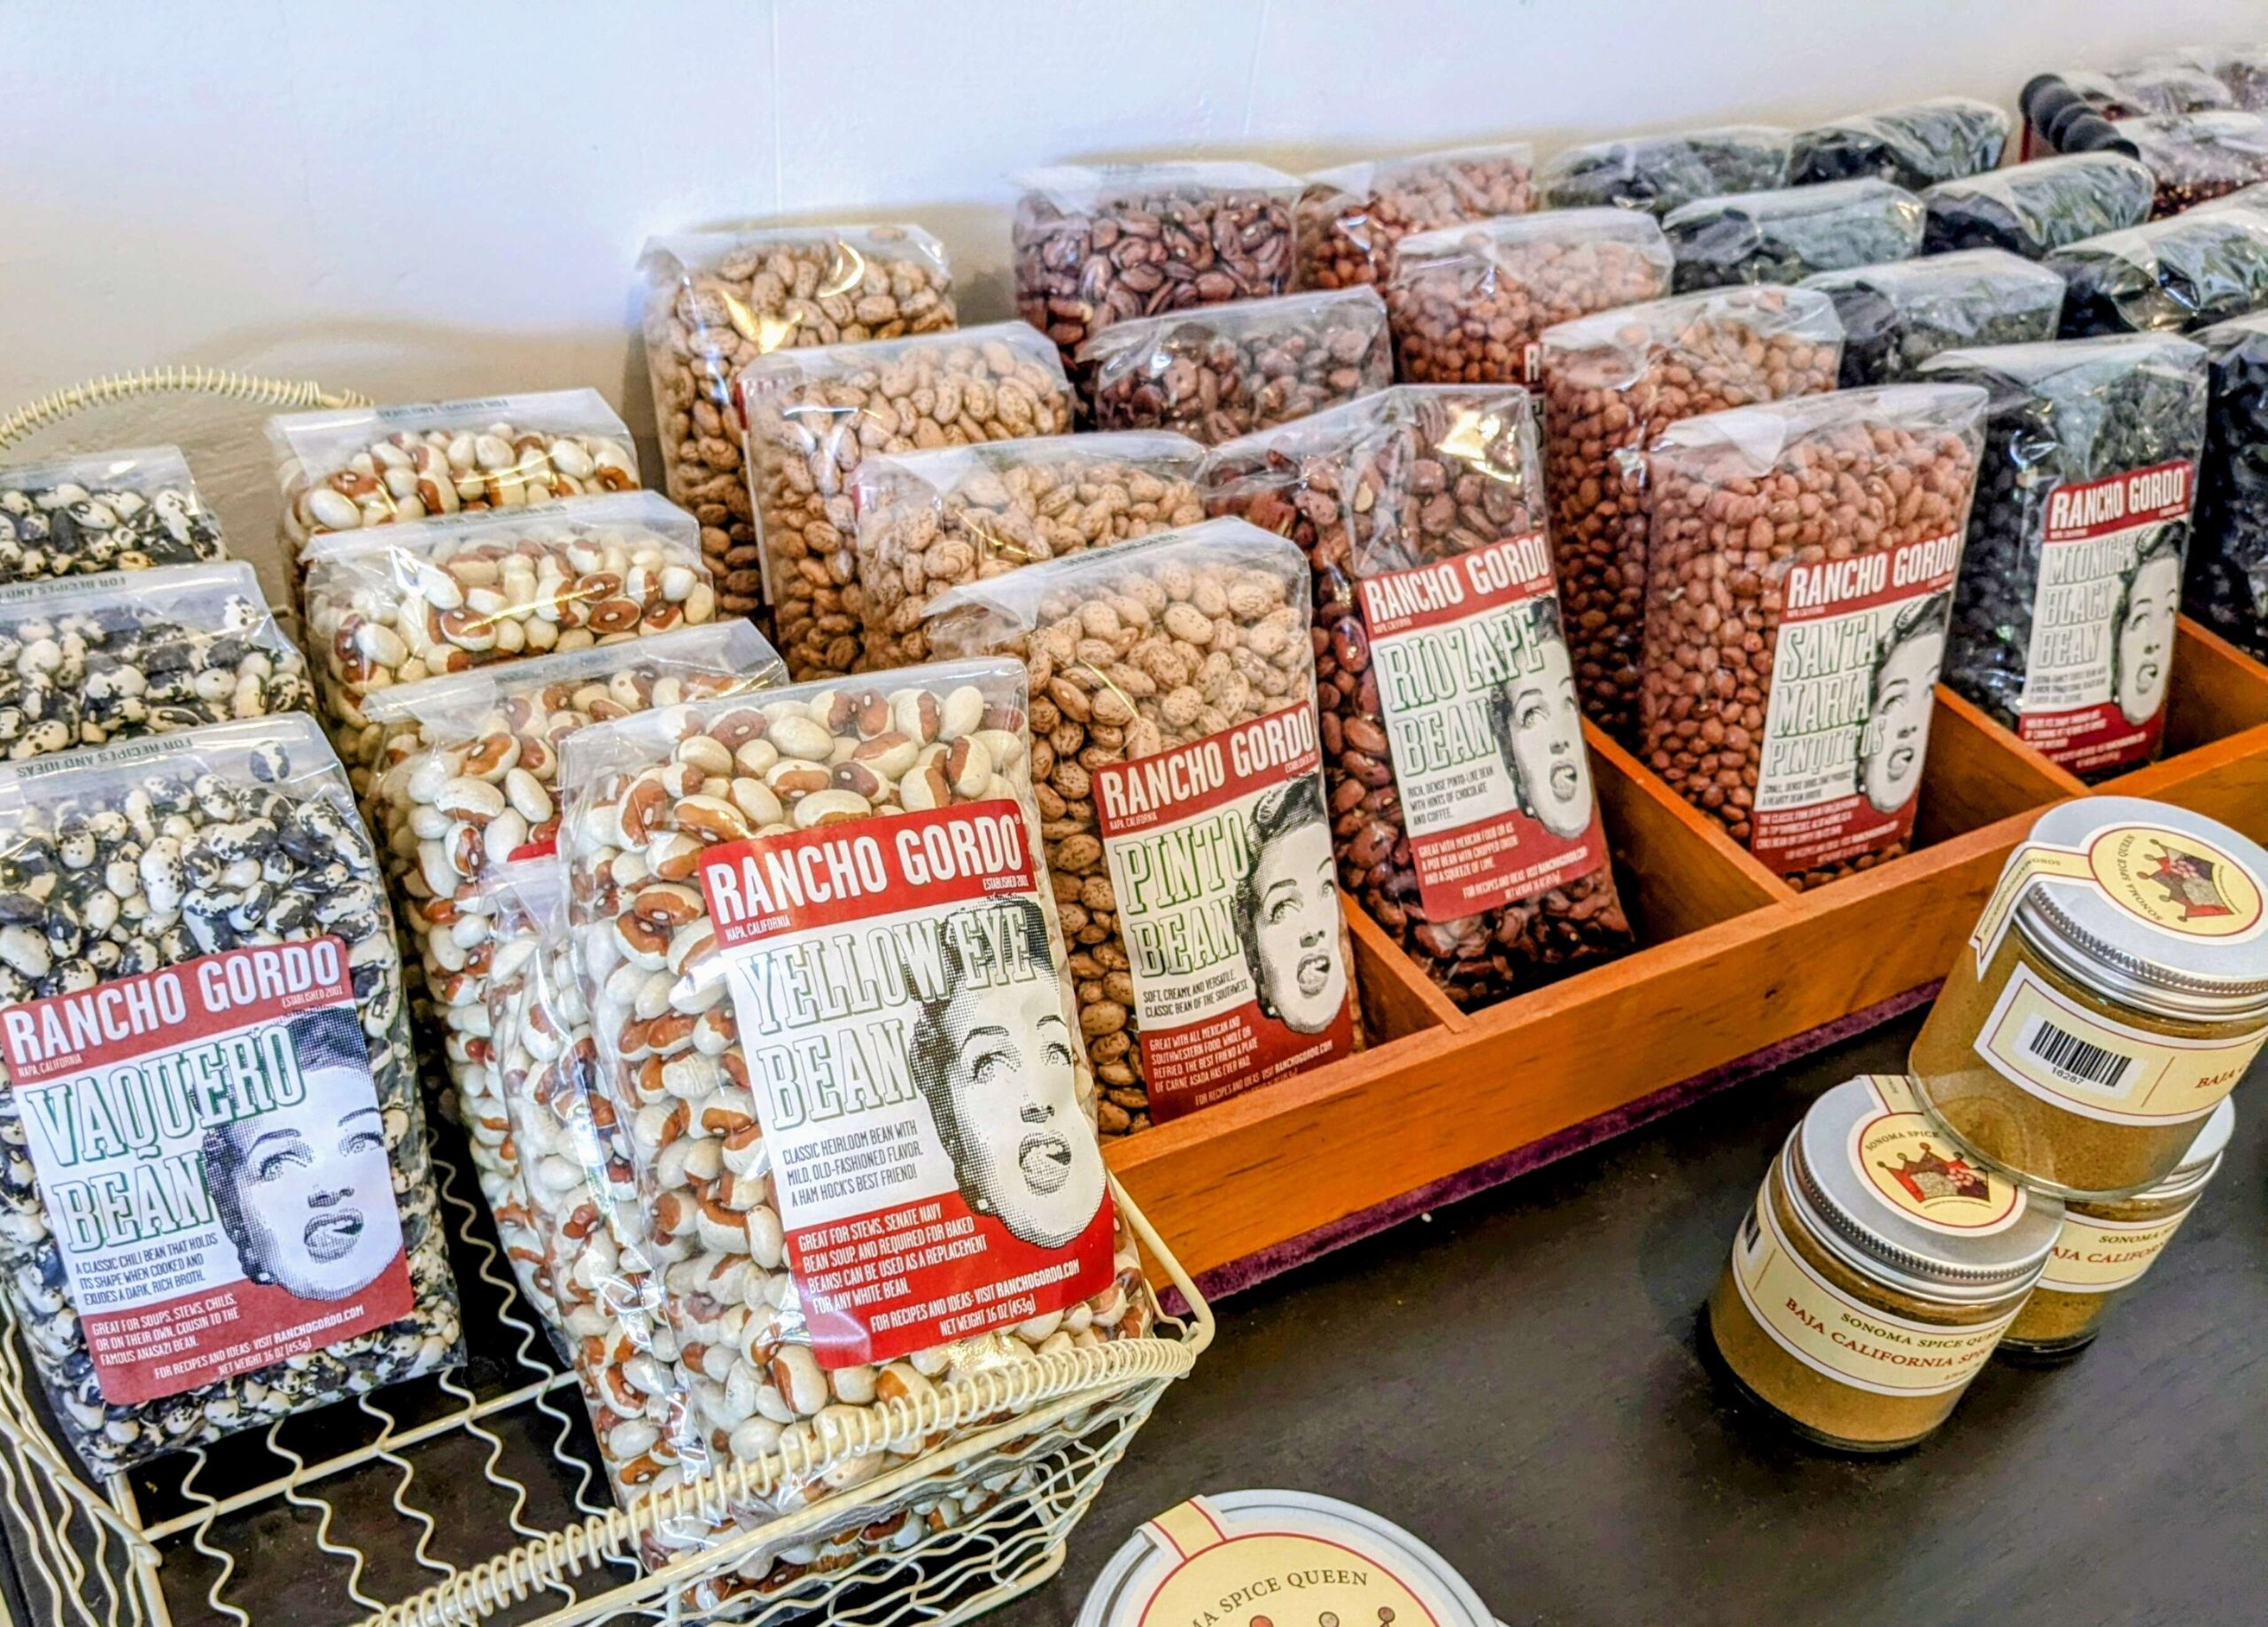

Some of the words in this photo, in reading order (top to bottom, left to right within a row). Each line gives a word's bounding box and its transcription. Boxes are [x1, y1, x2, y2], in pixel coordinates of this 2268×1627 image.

[2049, 478, 2126, 531] RANCHO
[2125, 466, 2186, 514] GORDO
[1363, 562, 1464, 624] RANCHO
[1464, 534, 1550, 597] GORDO
[1787, 552, 1888, 609] RANCHO
[1891, 532, 1958, 587] GORDO
[2041, 580, 2111, 629] BLACK
[1378, 631, 1456, 713] RIO
[1445, 605, 1544, 694] ZAPE
[1779, 612, 1879, 684] SANTA
[2036, 624, 2100, 670] BEAN
[1771, 669, 1872, 739] MARIA
[1394, 698, 1495, 778] BEAN
[1767, 718, 1885, 778] PINQUITOS
[1100, 739, 1224, 821] RANCHO
[1229, 705, 1314, 780] GORDO
[1115, 807, 1250, 918] PINTO
[2119, 834, 2135, 857] QUEEN
[704, 834, 889, 925] RANCHO
[982, 874, 1016, 891] ESTABLISHED
[2117, 858, 2129, 881] SPICE
[2127, 884, 2163, 921] SONOMA
[725, 924, 748, 941] NAPA,
[746, 915, 790, 934] CALIFORNIA
[1130, 895, 1239, 982] BEAN
[735, 918, 953, 1036] YELLOW
[951, 903, 1037, 992] EYE
[1, 971, 189, 1065] RANCHO
[281, 988, 325, 1009] ESTABLISHED
[324, 984, 343, 998] 2001
[1192, 996, 1201, 1009] OF
[39, 1052, 82, 1073] CALIFORNIA
[757, 1019, 917, 1133] BEAN
[24, 1022, 308, 1168] VAQUERO
[782, 1142, 820, 1166] CLASSIC
[819, 1130, 868, 1157] HEIRLOOM
[869, 1125, 894, 1145] BEAN
[894, 1120, 918, 1139] WITH
[787, 1166, 812, 1187] MILD,
[812, 1148, 886, 1182] OLD-FASHIONED
[886, 1139, 923, 1163] FLAVOR.
[1865, 1132, 1905, 1151] SONOMA
[51, 1150, 217, 1259] BEAN
[789, 1191, 797, 1206] A
[797, 1186, 819, 1205] HAM
[855, 1172, 880, 1192] BEST
[880, 1163, 917, 1186] FRIEND!
[797, 1228, 830, 1253] GREAT
[828, 1225, 850, 1245] FOR
[850, 1216, 885, 1241] STEWS,
[884, 1208, 919, 1232] SENATE
[919, 1202, 943, 1223] NAVY
[802, 1251, 829, 1274] BEAN
[828, 1244, 858, 1267] SOUP,
[857, 1240, 878, 1260] AND
[878, 1228, 925, 1257] REQUIRED
[925, 1223, 944, 1243] FOR
[944, 1215, 975, 1239] BAKED
[2099, 1233, 2158, 1243] SONOMA
[74, 1262, 82, 1274] A
[82, 1254, 118, 1276] CLASSIC
[118, 1251, 143, 1268] CHILI
[143, 1245, 167, 1262] BEAN
[167, 1240, 187, 1256] THAT
[189, 1232, 218, 1251] HOLDS
[79, 1276, 94, 1290] ITS
[95, 1272, 123, 1290] SHAPE
[123, 1267, 148, 1283] WHEN
[150, 1258, 185, 1278] COOKED
[185, 1252, 204, 1268] AND
[807, 1270, 843, 1296] BEANS!
[843, 1266, 864, 1287] CAN
[864, 1262, 878, 1281] BE
[878, 1256, 905, 1278] USED
[904, 1252, 918, 1271] AS
[917, 1251, 926, 1267] A
[925, 1234, 987, 1266] REPLACEMENT
[2050, 1246, 2080, 1261] AJA
[84, 1287, 117, 1307] EXUDES
[118, 1289, 124, 1300] A
[151, 1277, 174, 1293] RICH
[174, 1268, 206, 1288] BROTH.
[812, 1295, 834, 1314] FOR
[833, 1290, 855, 1310] ANY
[853, 1283, 882, 1306] WHITE
[882, 1275, 911, 1300] BEAN.
[869, 1313, 889, 1333] FOR
[889, 1302, 928, 1329] RECIPES
[927, 1298, 947, 1318] AND
[946, 1290, 975, 1313] IDEAS:
[974, 1284, 996, 1305] VISIT
[995, 1258, 1081, 1298] RANCHOGORDO.COM
[91, 1319, 120, 1336] GREAT
[120, 1316, 140, 1332] FOR
[95, 1337, 110, 1352] OR
[110, 1335, 124, 1349] ON
[125, 1329, 151, 1346] THEIR
[175, 1315, 209, 1335] COUSIN
[210, 1312, 221, 1325] TO
[221, 1306, 240, 1322] THE
[153, 1364, 173, 1380] FOR
[172, 1354, 208, 1375] RECIPES
[207, 1349, 225, 1364] AND
[252, 1334, 273, 1351] VISIT
[272, 1305, 364, 1344] RANCHOGORDO.COM
[939, 1317, 957, 1337] NET
[956, 1308, 987, 1332] WEIGHT
[985, 1305, 998, 1322] 16
[997, 1302, 1008, 1320] OZ
[1786, 1297, 1825, 1335] BAJA
[1831, 1332, 1953, 1367] CALIFORNIA
[1841, 1313, 1912, 1345] SONOMA
[1917, 1339, 1964, 1349] SPICE
[100, 1347, 135, 1367] FAMOUS
[136, 1341, 172, 1360] ANASAZI
[173, 1334, 199, 1352] BEAN.
[218, 1361, 234, 1375] NET
[233, 1353, 262, 1371] WEIGHT
[262, 1349, 274, 1361] 16
[273, 1345, 284, 1359] OZ
[1219, 1577, 1282, 1614] SPICE
[1286, 1569, 1369, 1587] QUEEN
